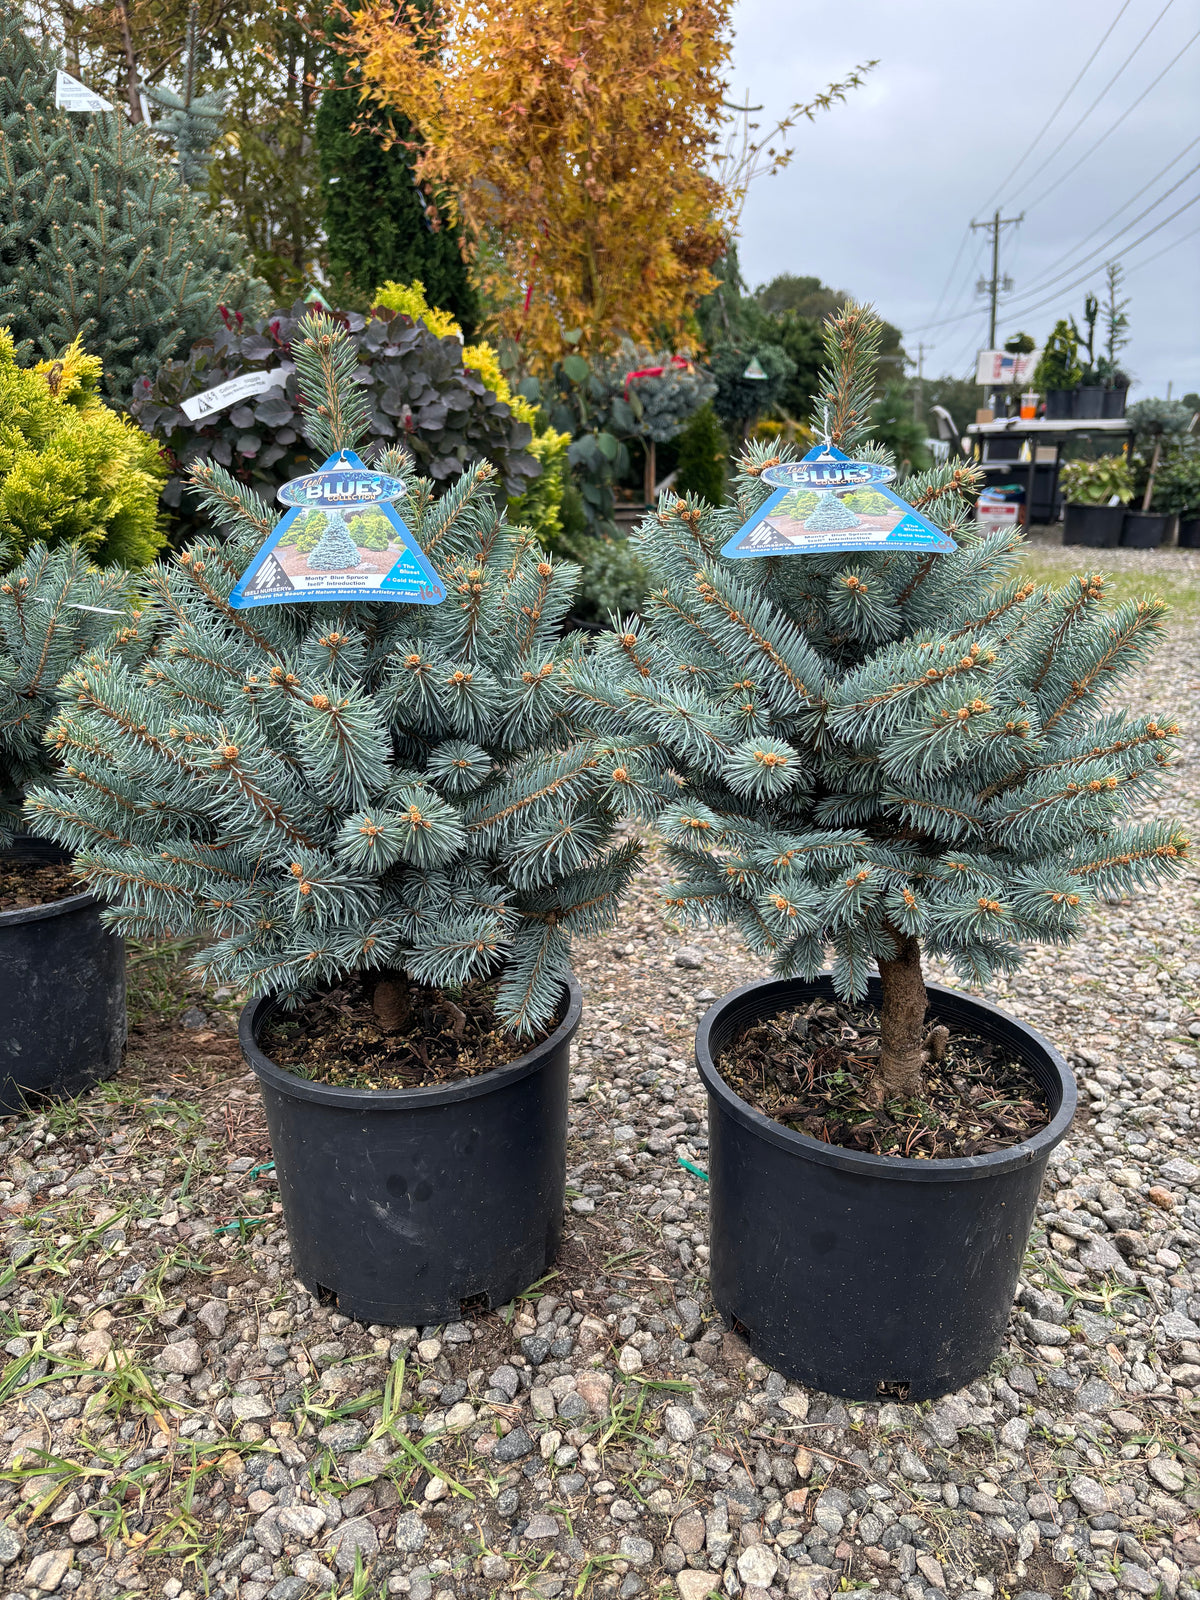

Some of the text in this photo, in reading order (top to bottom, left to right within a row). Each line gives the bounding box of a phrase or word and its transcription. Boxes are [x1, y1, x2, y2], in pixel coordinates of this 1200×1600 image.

[792, 469, 872, 483] BLUES
[815, 478, 866, 486] COLLECTION
[306, 480, 382, 499] BLUES
[327, 494, 376, 502] COLLECTION
[419, 585, 443, 601] 169
